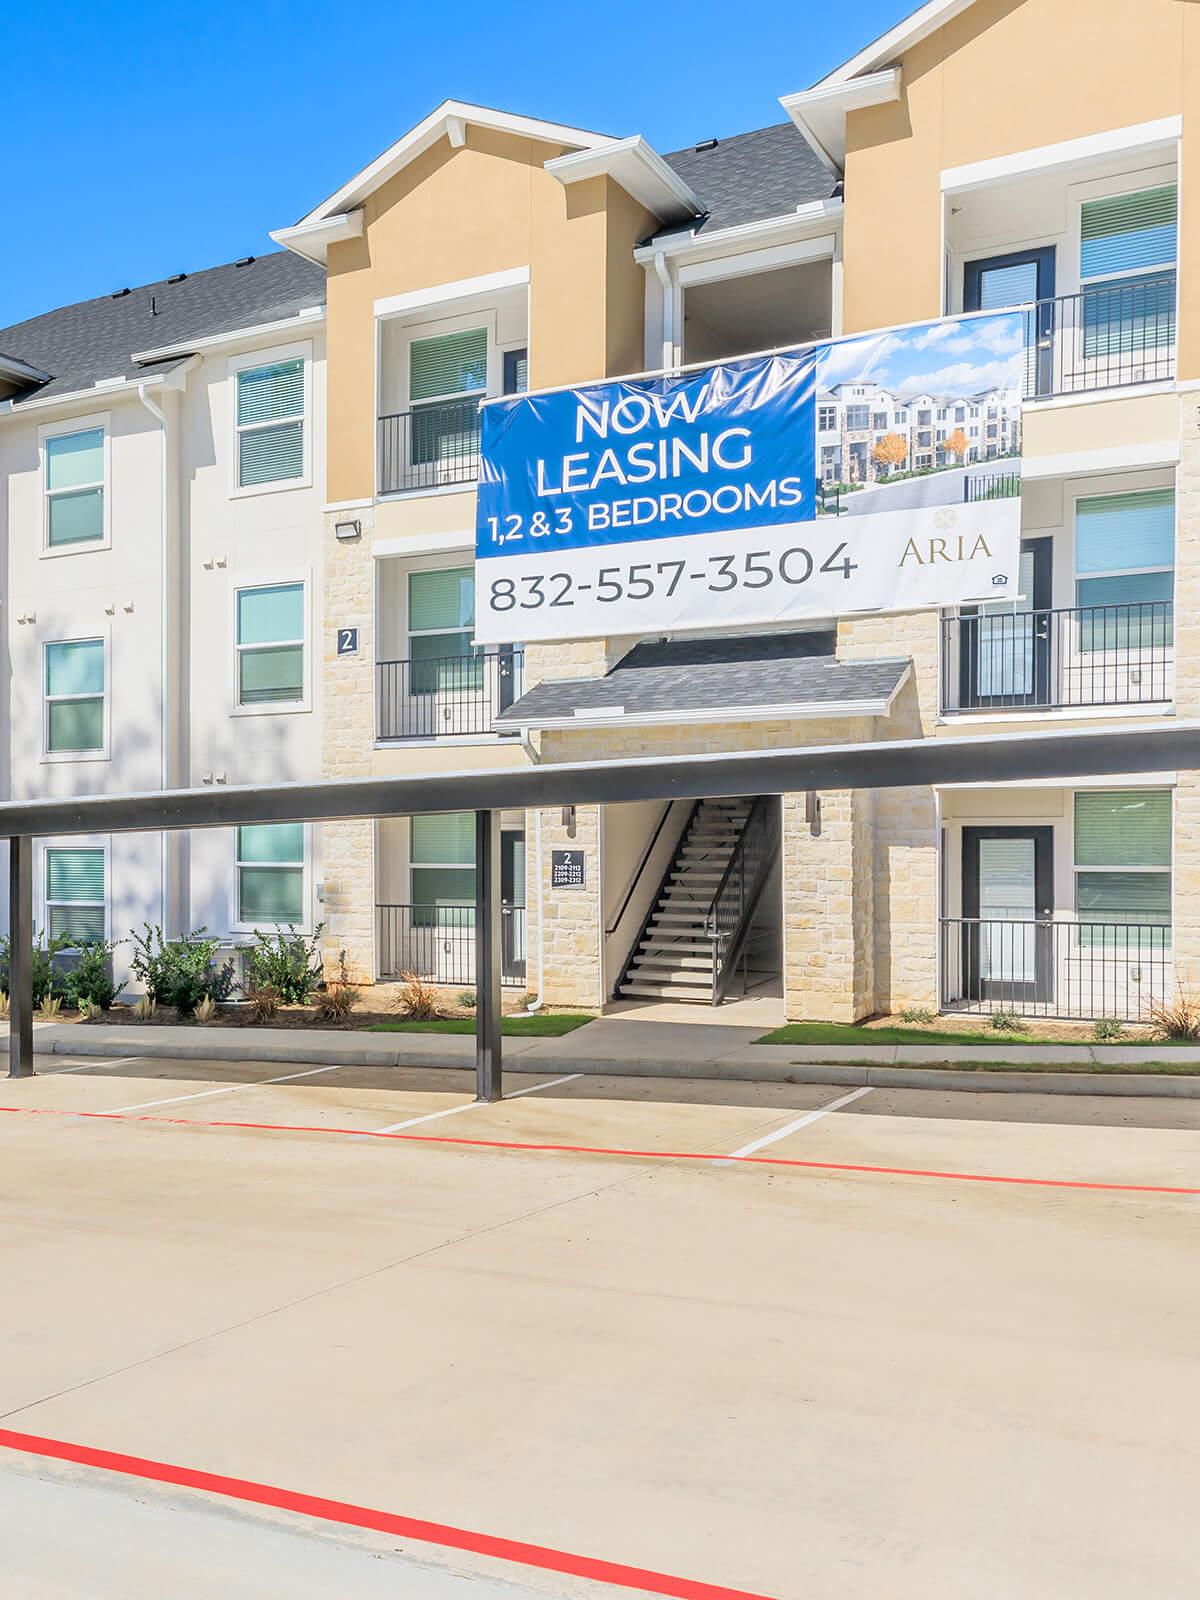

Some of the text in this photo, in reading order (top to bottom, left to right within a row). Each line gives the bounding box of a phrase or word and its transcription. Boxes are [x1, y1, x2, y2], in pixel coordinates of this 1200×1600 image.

[575, 384, 710, 443] NOW
[537, 428, 752, 497] LEASING
[588, 477, 803, 530] BEDROOMS
[898, 533, 992, 567] ARIA
[489, 542, 858, 612] 832-557-3504
[342, 630, 352, 649] 2
[563, 852, 572, 864] 2
